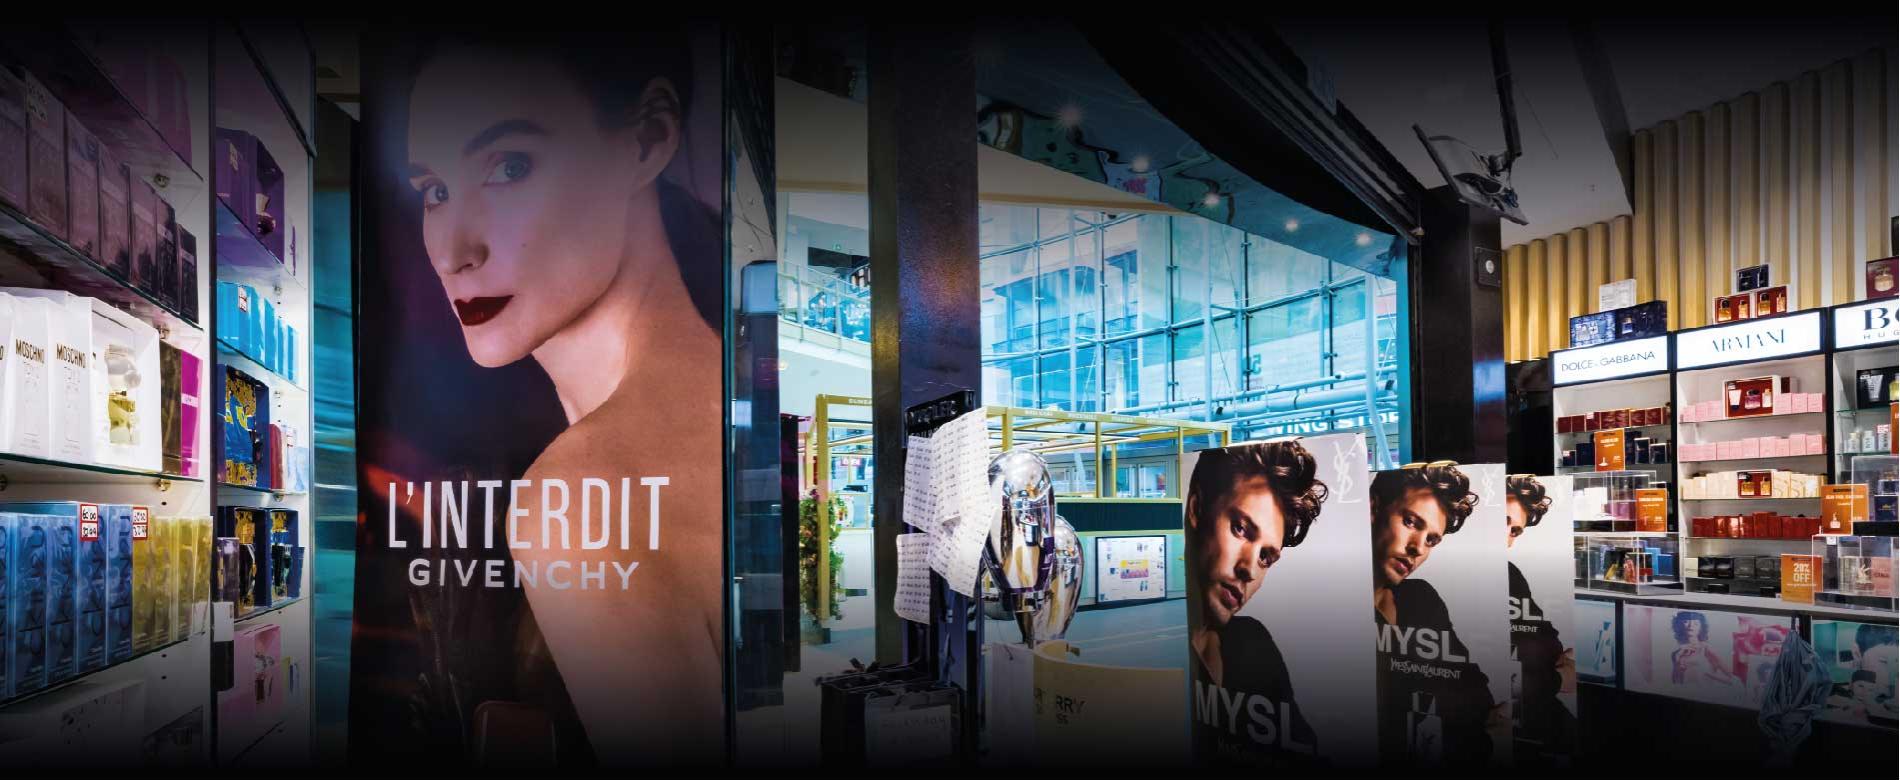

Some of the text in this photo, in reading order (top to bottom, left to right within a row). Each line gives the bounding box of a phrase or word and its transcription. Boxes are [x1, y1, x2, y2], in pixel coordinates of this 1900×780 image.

[1711, 328, 1786, 352] ARMANI
[1561, 359, 1593, 372] DOLCE
[1600, 351, 1656, 366] GABBANA
[388, 476, 671, 550] L'INTERDIT
[408, 558, 640, 590] GIVENCHY
[1793, 573, 1810, 583] OFF
